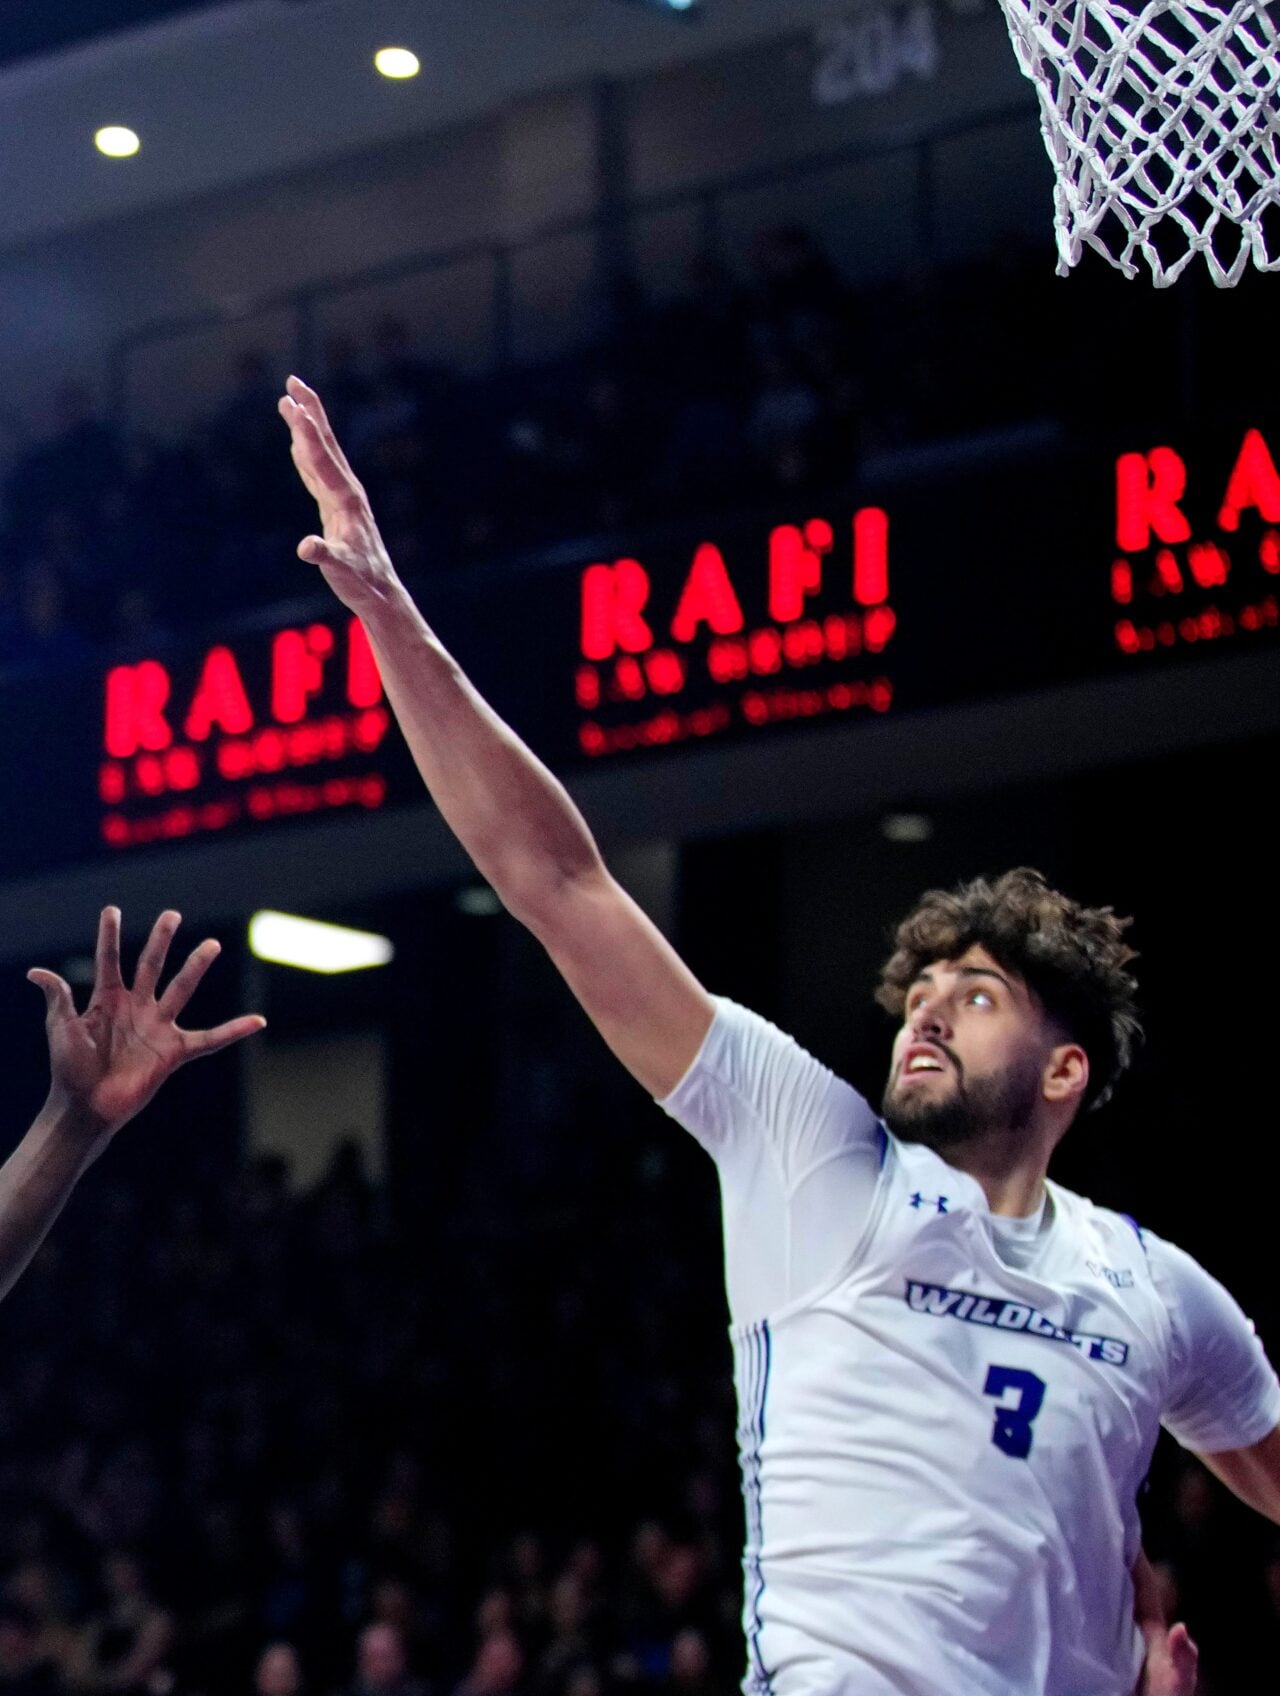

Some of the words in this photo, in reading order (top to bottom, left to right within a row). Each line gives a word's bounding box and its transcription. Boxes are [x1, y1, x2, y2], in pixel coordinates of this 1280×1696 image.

[581, 507, 889, 661] RAFI
[907, 1282, 1129, 1364] WILDCTS
[983, 1363, 1047, 1460] 3
